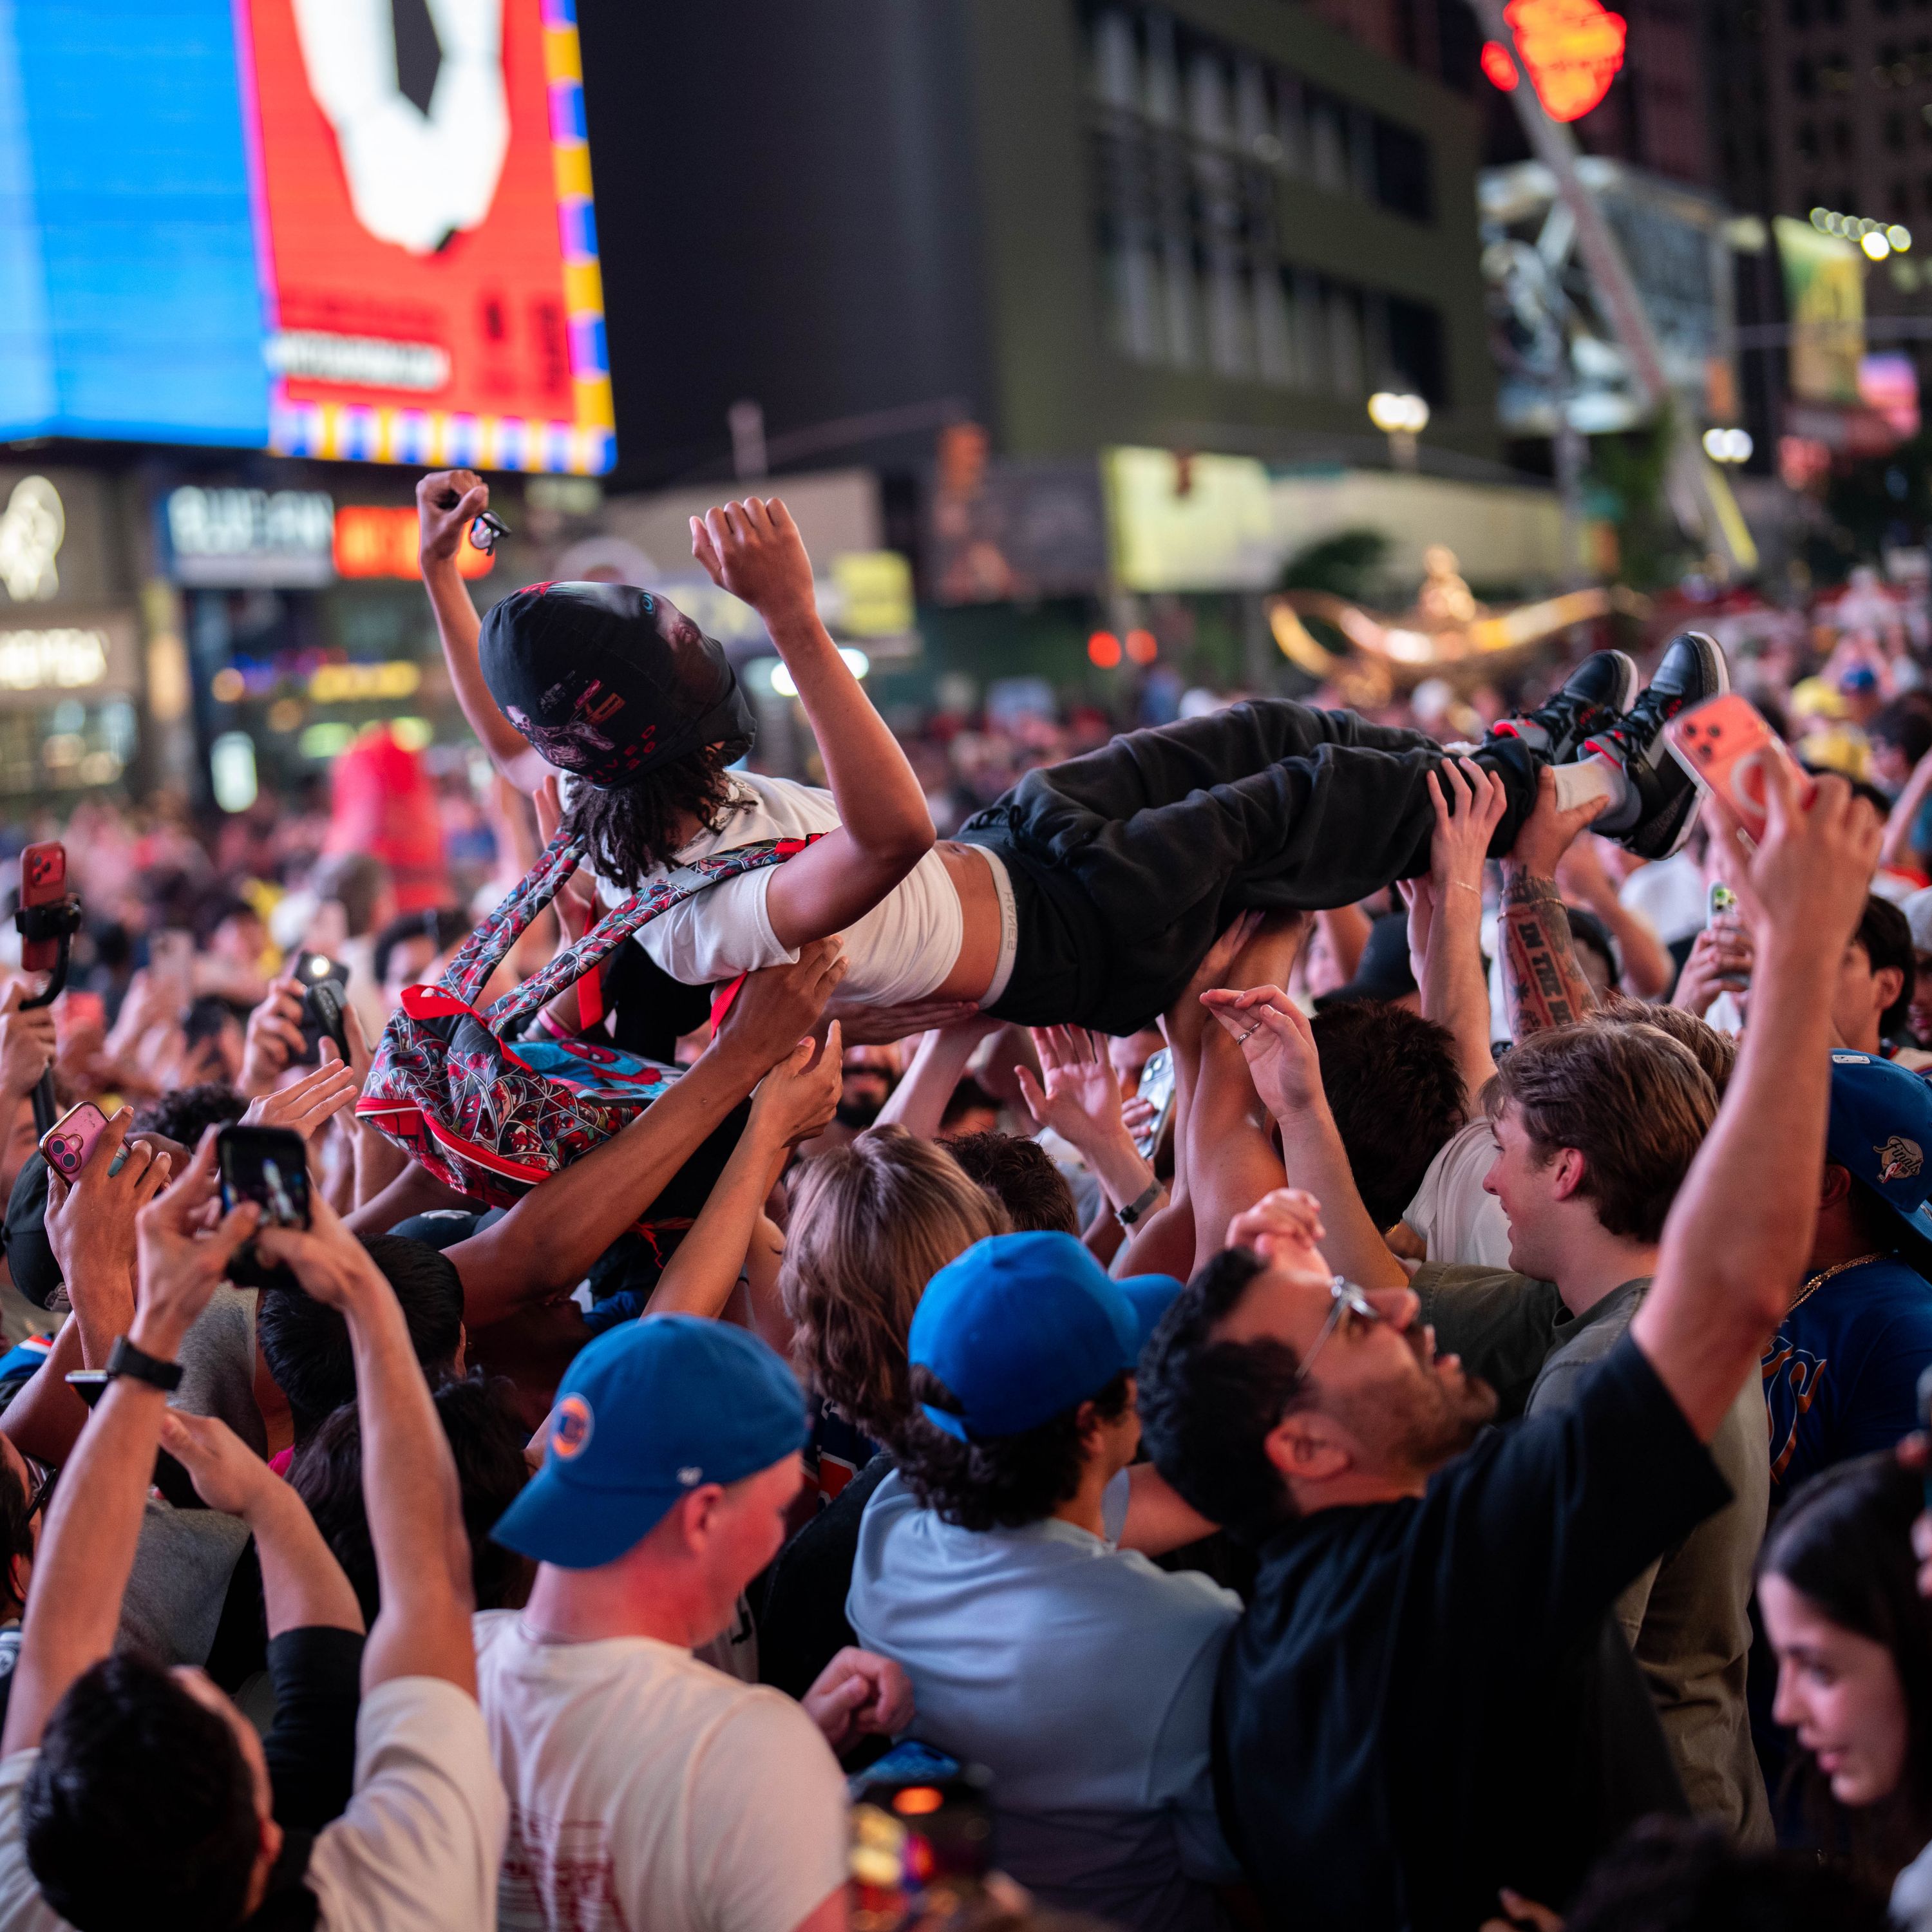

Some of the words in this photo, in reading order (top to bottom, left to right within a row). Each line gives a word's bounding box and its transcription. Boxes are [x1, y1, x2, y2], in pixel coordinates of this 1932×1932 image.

[1518, 922, 1544, 949] IN
[1532, 951, 1562, 997] THE
[1874, 1137, 1923, 1175] Finals
